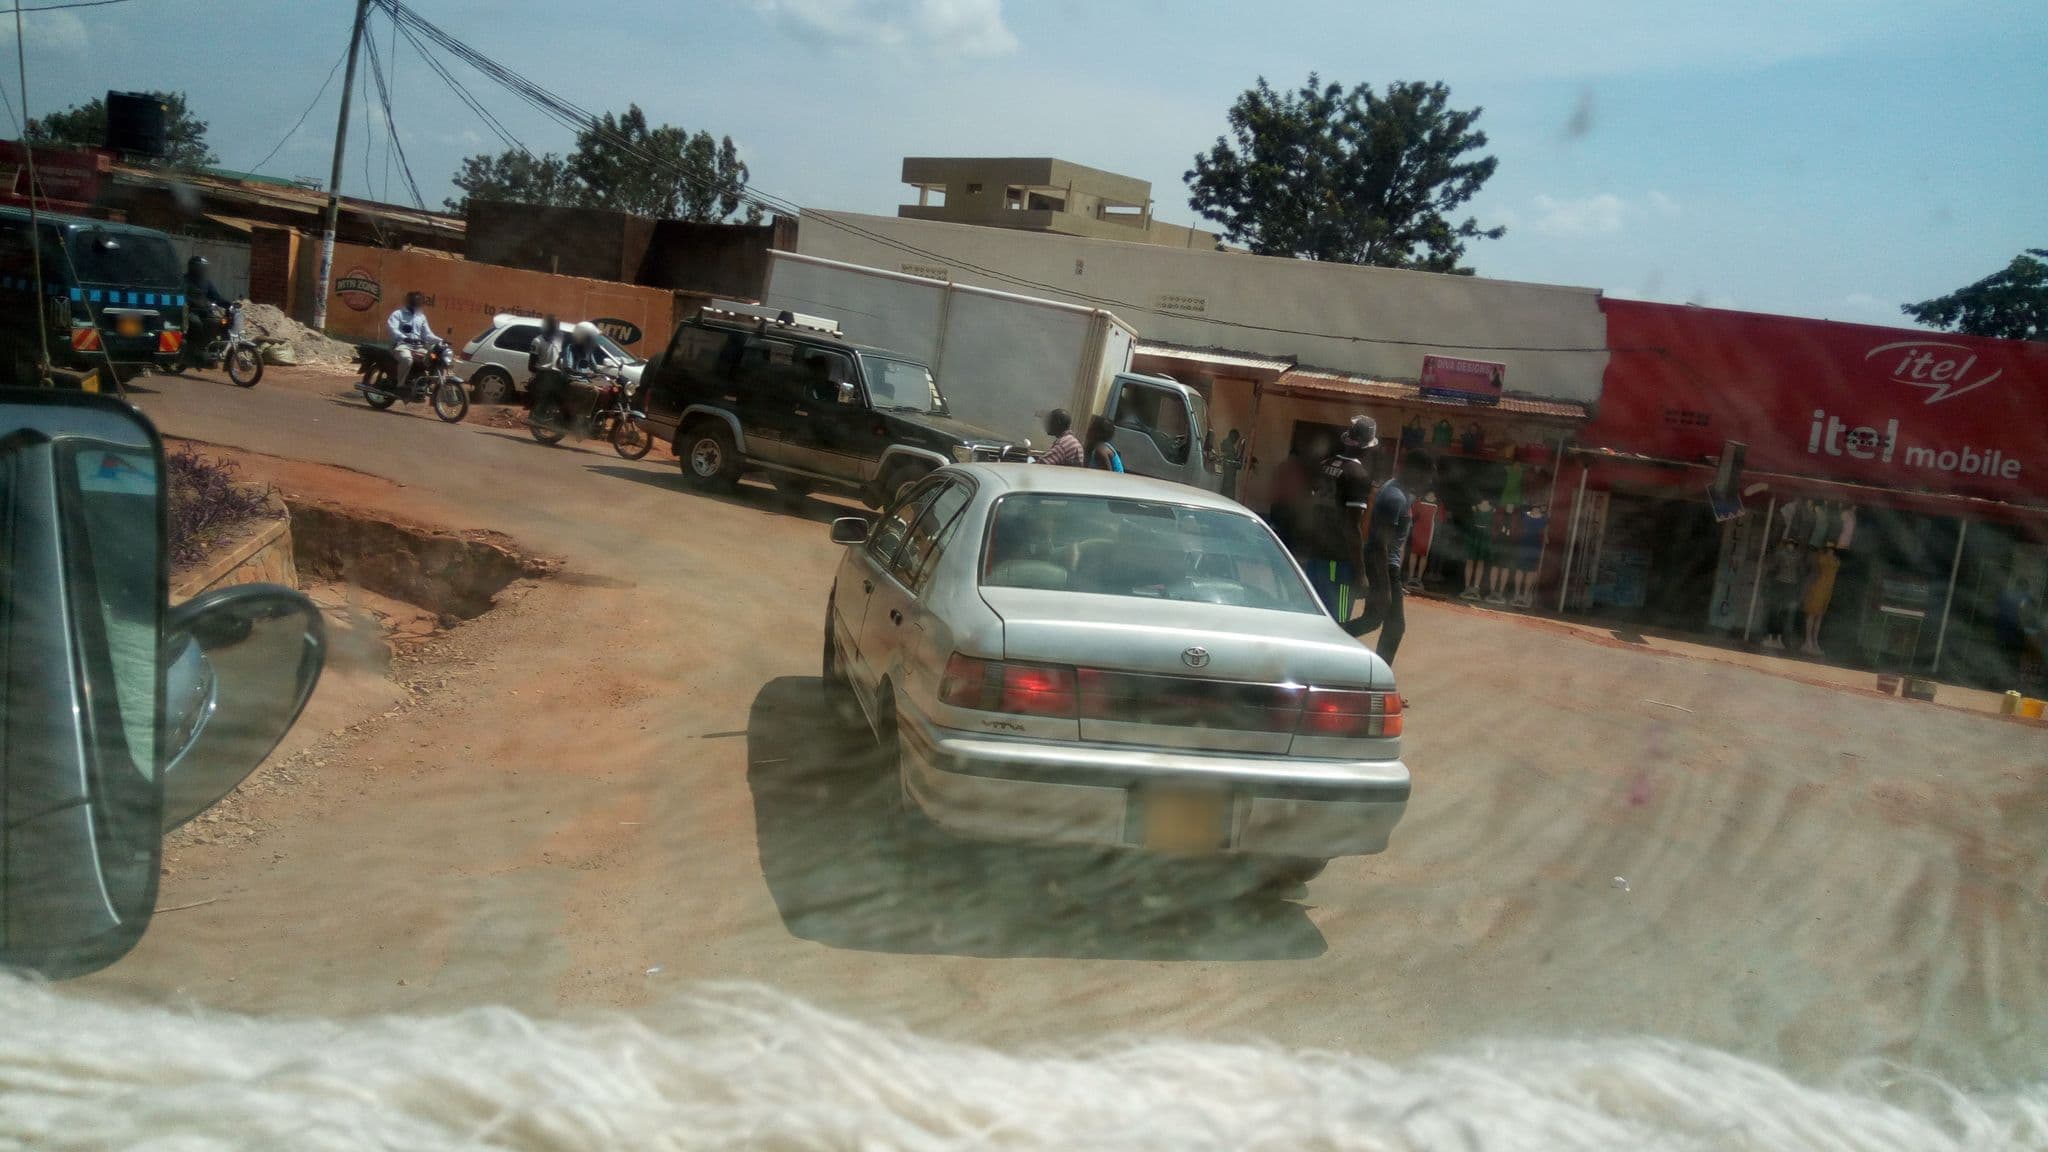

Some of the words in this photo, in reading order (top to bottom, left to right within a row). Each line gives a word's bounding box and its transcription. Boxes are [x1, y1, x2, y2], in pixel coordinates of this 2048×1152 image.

[1894, 349, 1978, 382] itel
[1807, 409, 1900, 463] itel
[1904, 445, 2023, 480] mobile
